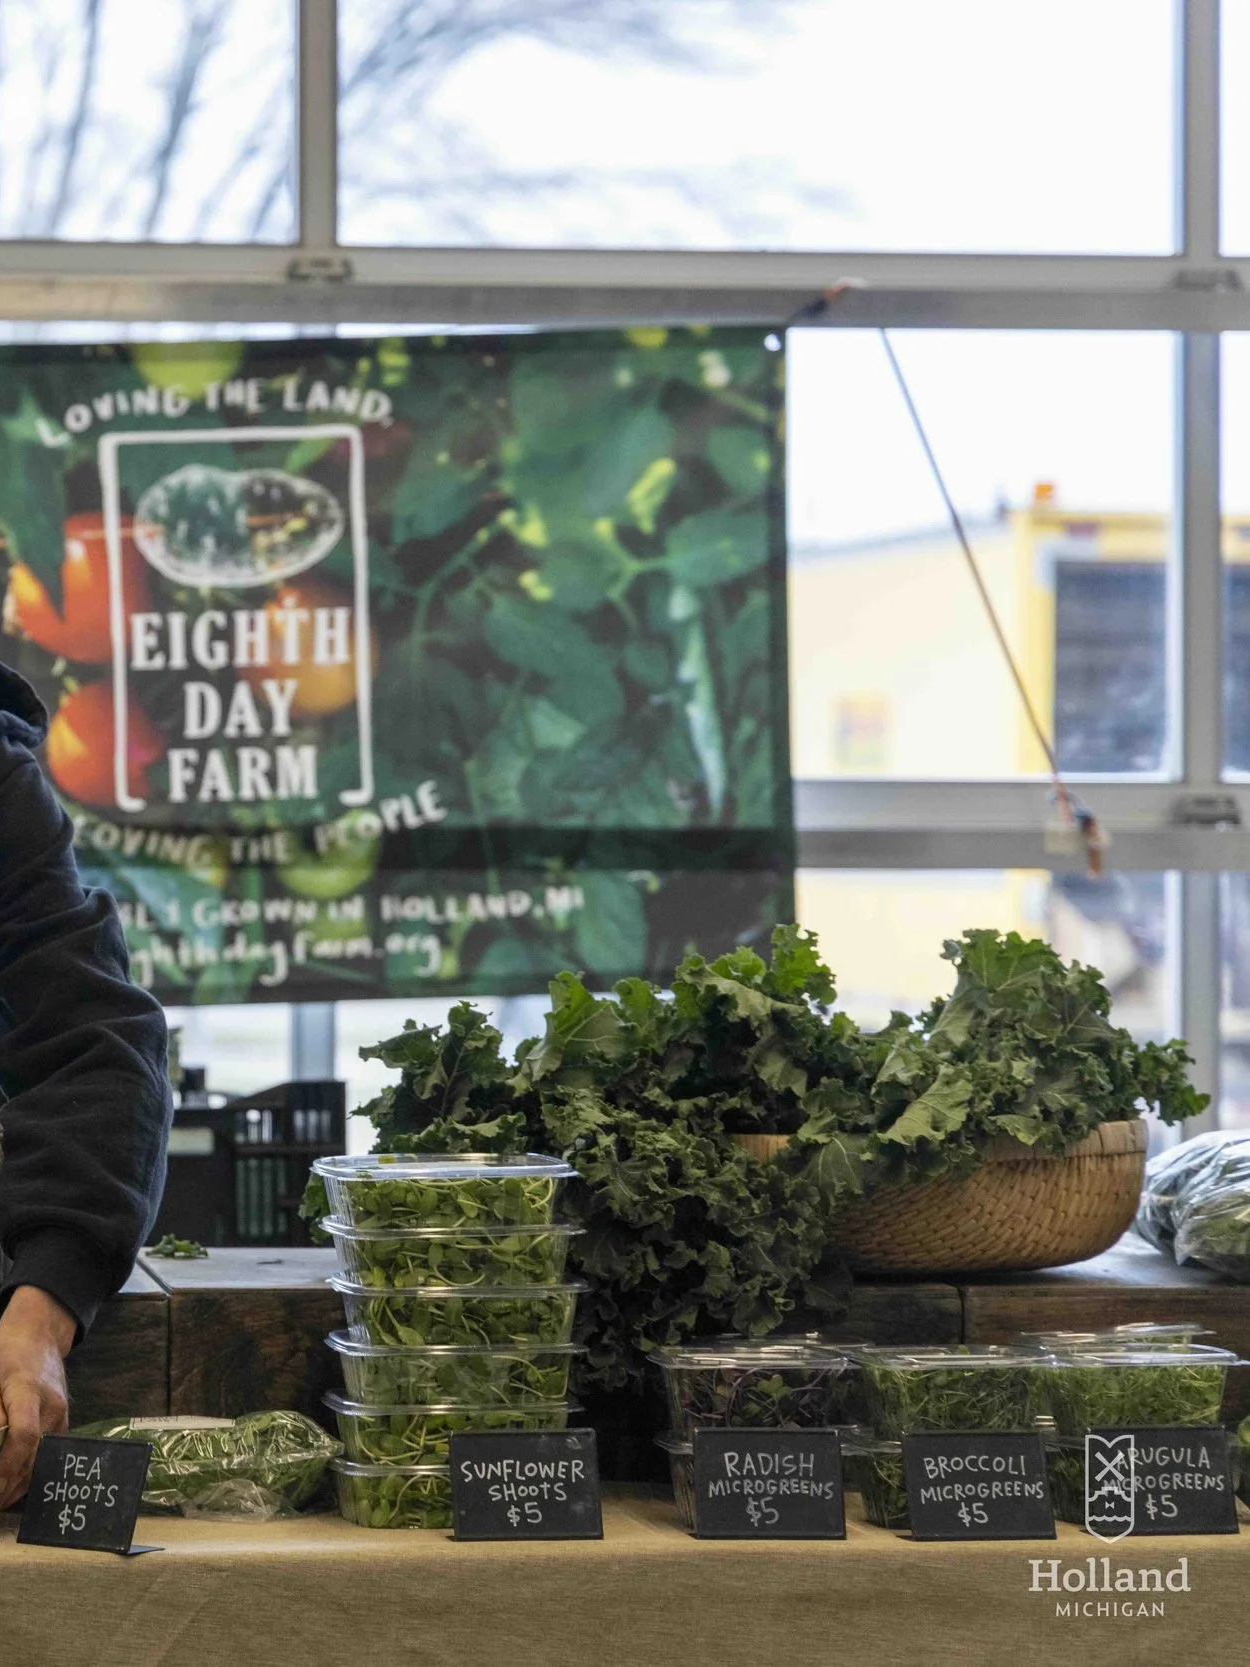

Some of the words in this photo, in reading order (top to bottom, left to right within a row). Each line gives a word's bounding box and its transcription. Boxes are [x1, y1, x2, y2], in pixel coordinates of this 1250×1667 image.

[35, 383, 190, 448] LOVING
[205, 376, 265, 414] THE
[130, 597, 352, 671] EIGHTH
[183, 679, 298, 739] DAY
[168, 745, 318, 803] FARM
[231, 830, 290, 865] THE
[314, 779, 448, 854] PEOPLE
[192, 897, 319, 929] GROWN
[327, 895, 365, 922] IN
[546, 884, 584, 911] MI
[63, 1453, 101, 1481] PEA
[460, 1459, 585, 1483] SUNFLOWER
[724, 1451, 814, 1477] RADISH
[923, 1455, 1026, 1479] BROCCOLI
[1116, 1446, 1210, 1471] ARUGULA
[43, 1481, 118, 1508] SHOOTS
[488, 1481, 567, 1501] SHOOTS
[708, 1478, 834, 1500] MICROGREENS
[920, 1481, 1044, 1505] MICROGREENS
[1103, 1472, 1225, 1497] MICROGREENS
[58, 1503, 86, 1535] $5
[506, 1502, 543, 1527] $5
[746, 1496, 780, 1527] $5
[957, 1502, 989, 1527] $5
[1145, 1493, 1178, 1520] $5
